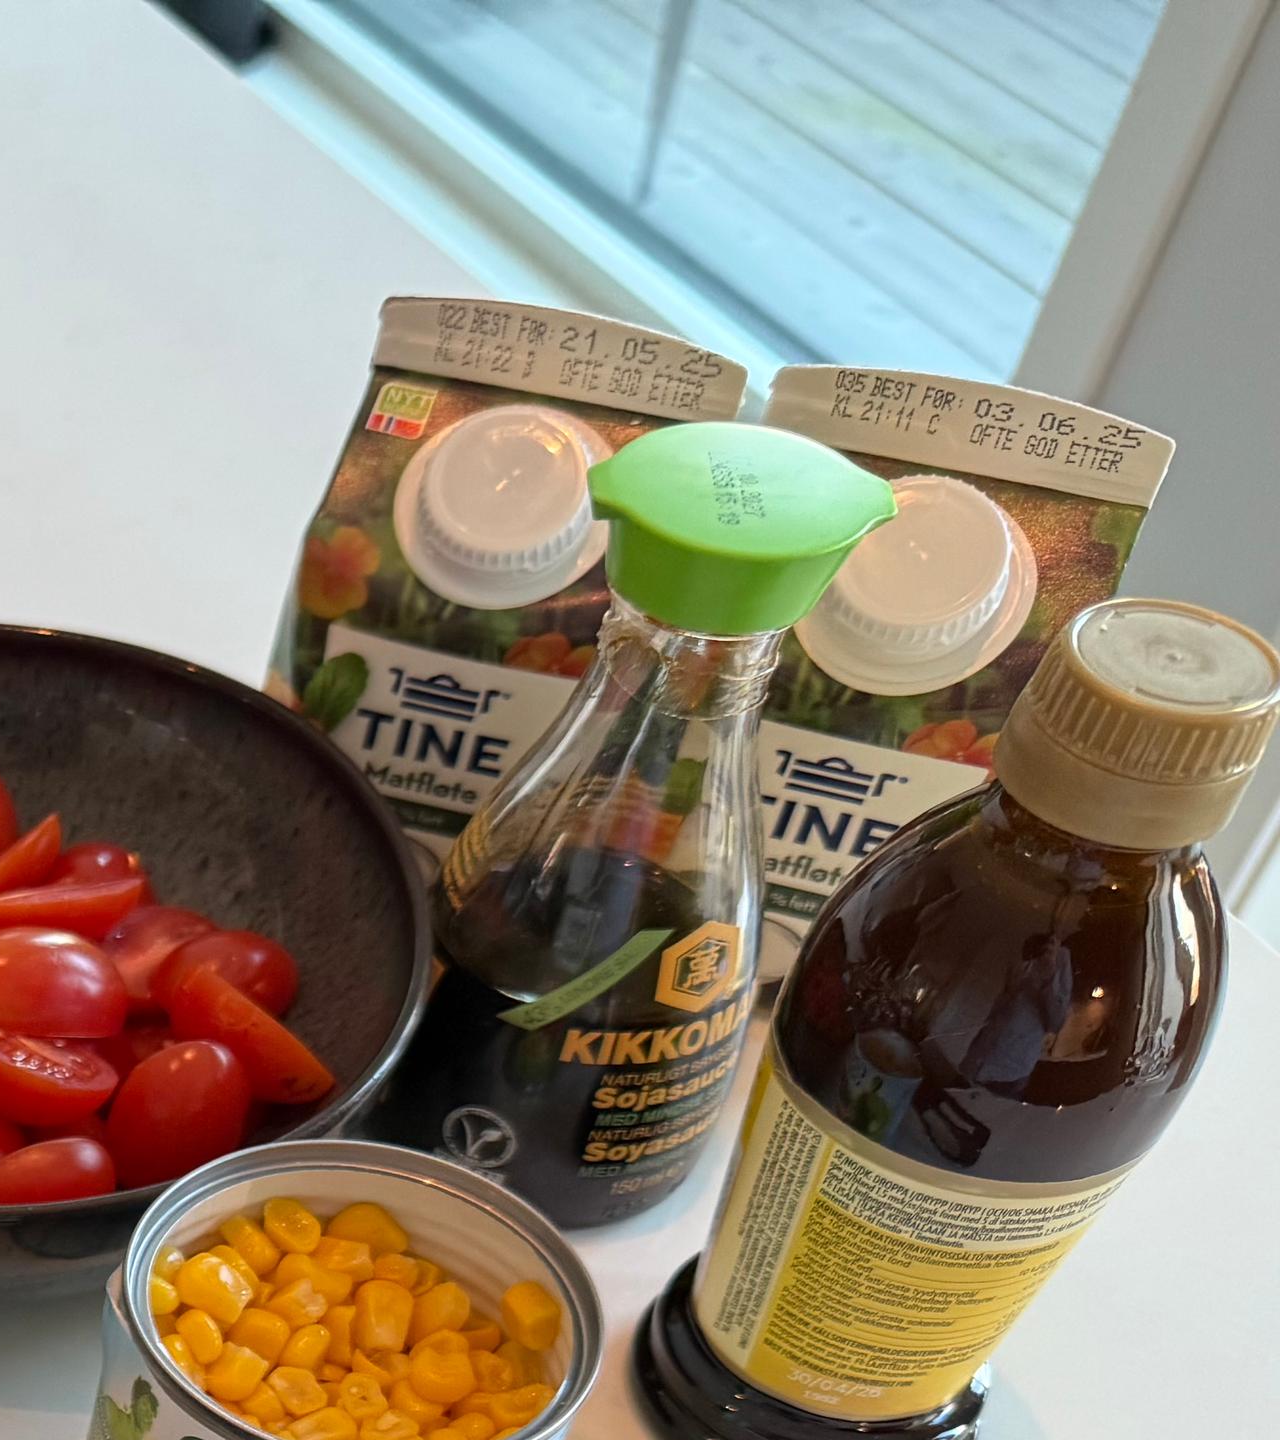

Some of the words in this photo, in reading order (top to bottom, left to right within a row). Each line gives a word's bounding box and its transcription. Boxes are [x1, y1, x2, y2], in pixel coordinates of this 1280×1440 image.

[469, 307, 512, 340] BEST
[559, 357, 604, 391] OFTE
[608, 366, 643, 397] GOD
[648, 366, 705, 411] ETTER
[835, 370, 866, 395] 035
[870, 376, 917, 402] BEST
[830, 393, 853, 419] KL
[859, 401, 914, 431] 21:11
[928, 414, 941, 436] C
[970, 423, 1017, 451] OFTE
[1024, 434, 1059, 460] GOD
[1065, 440, 1123, 473] ETTER
[357, 708, 510, 778] TINE
[765, 855, 842, 886] atfløt
[873, 1174, 909, 1197] DROPPA
